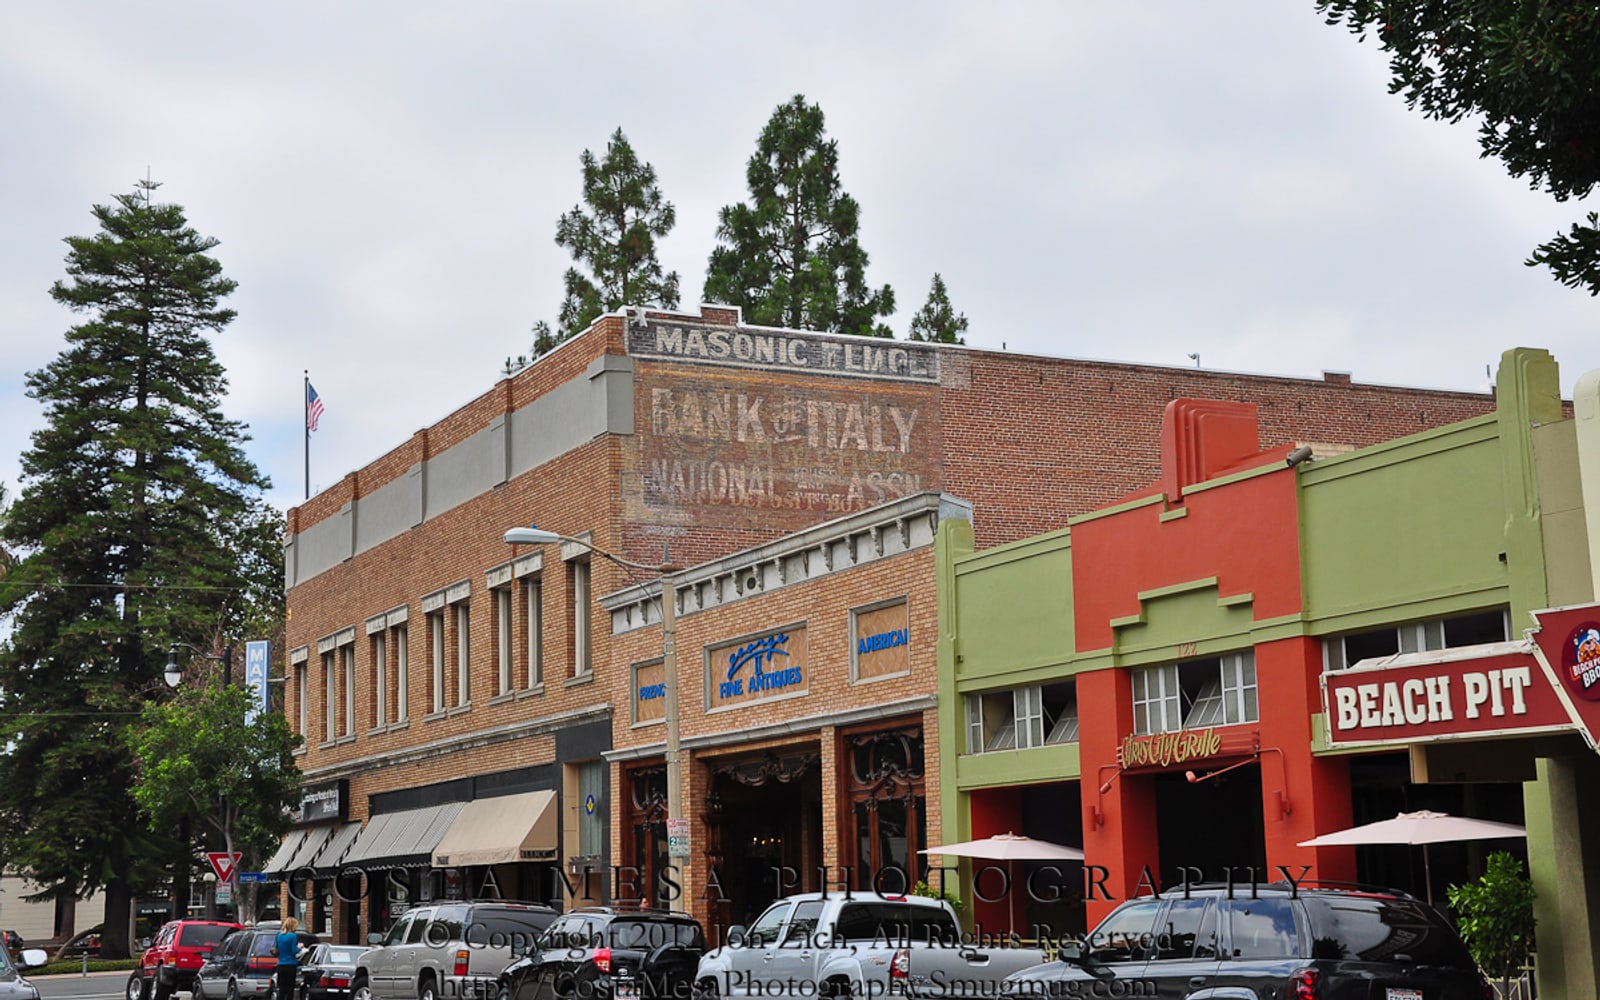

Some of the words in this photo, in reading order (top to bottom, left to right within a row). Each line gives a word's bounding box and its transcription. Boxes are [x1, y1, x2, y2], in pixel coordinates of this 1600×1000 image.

[656, 325, 808, 366] MASONIC
[652, 387, 768, 443] BANK
[807, 400, 919, 453] ITALY
[651, 459, 774, 502] NATIONAL
[1177, 642, 1198, 658] 122
[720, 680, 743, 699] FINE
[748, 666, 802, 692] ANTIQUES
[1335, 675, 1453, 730] BEACH
[1463, 666, 1532, 719] PIT
[1149, 730, 1175, 767] City
